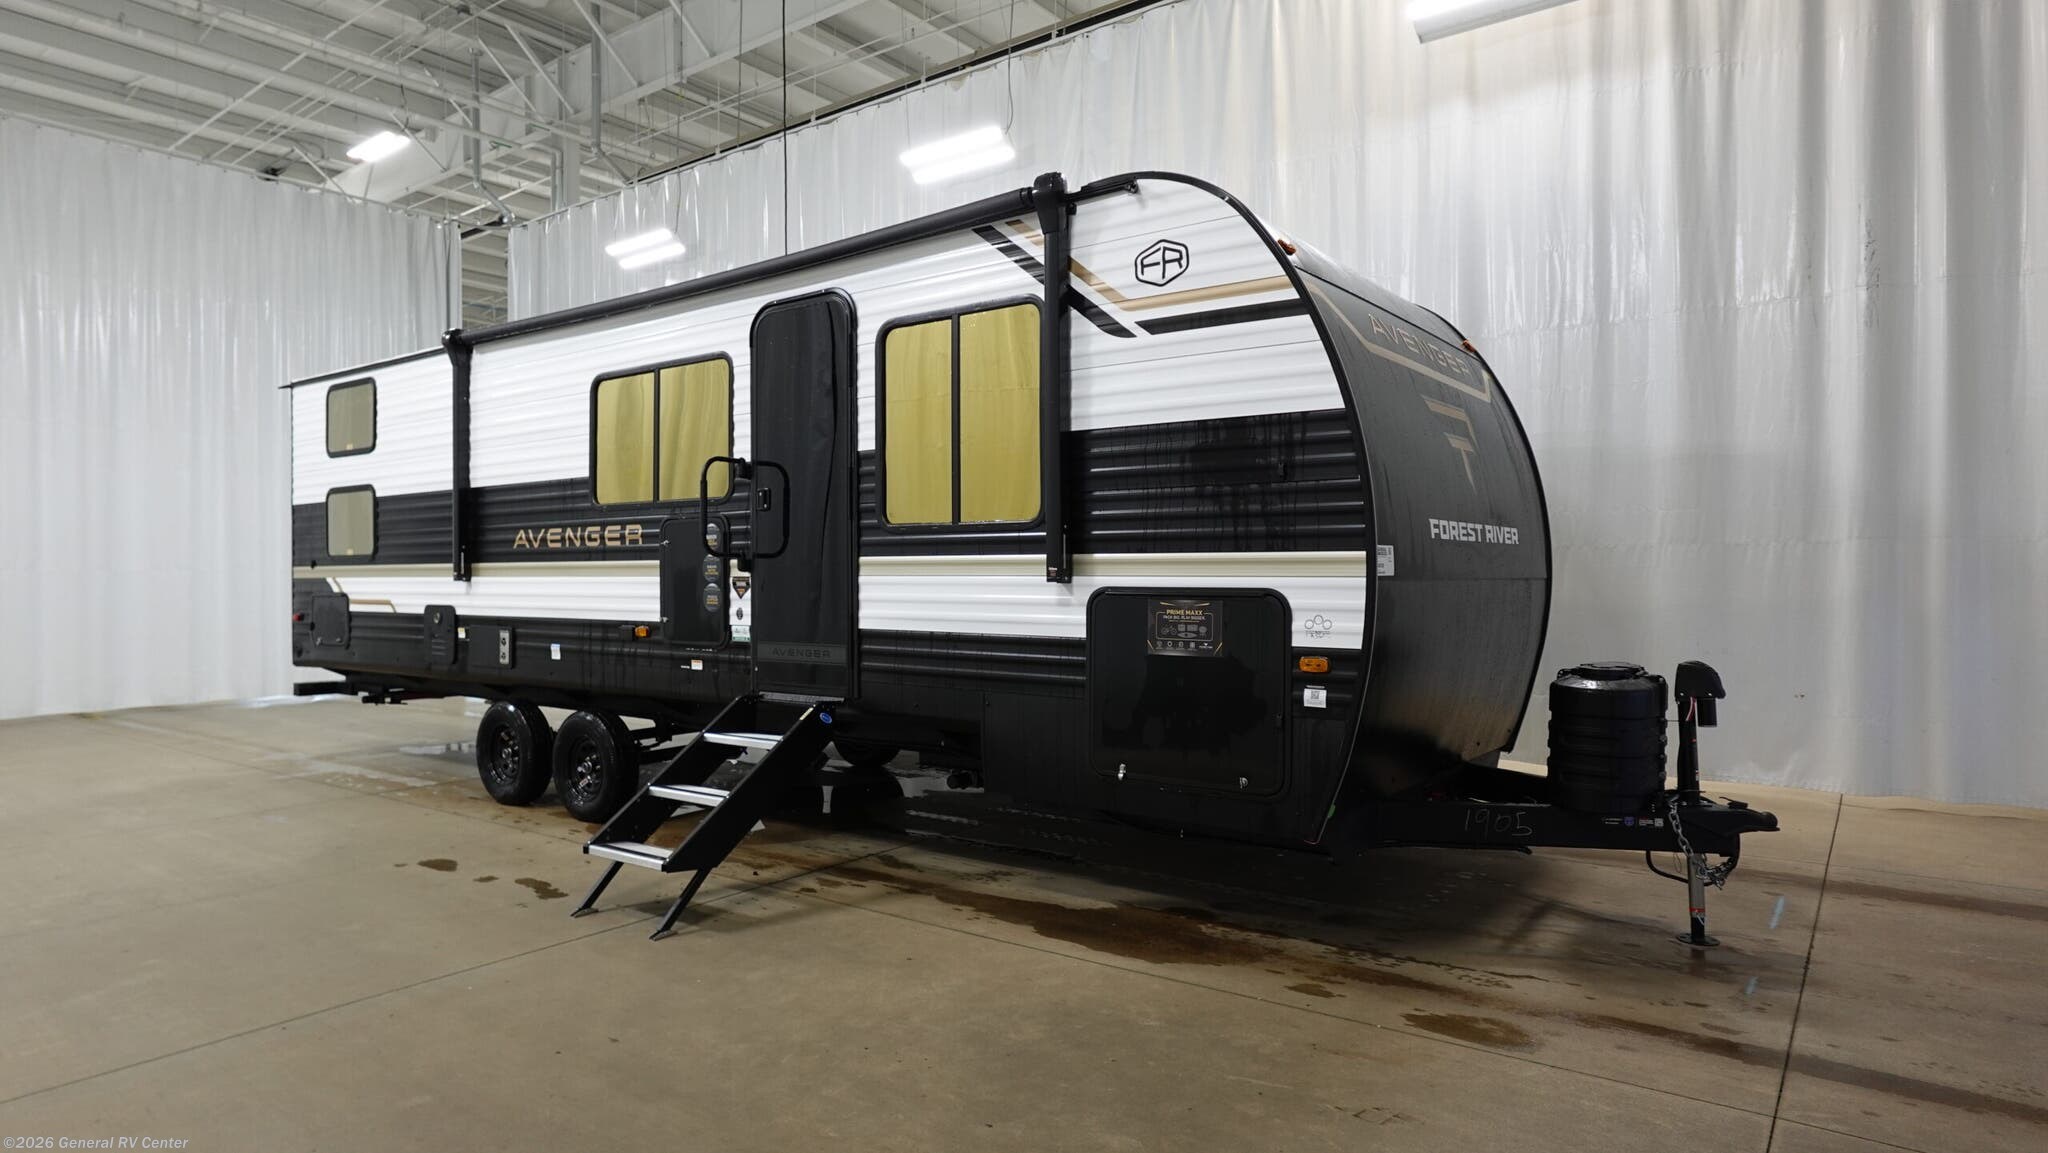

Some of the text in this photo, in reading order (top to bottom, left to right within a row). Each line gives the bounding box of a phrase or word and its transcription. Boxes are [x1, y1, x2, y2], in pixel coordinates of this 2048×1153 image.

[1140, 245, 1183, 280] FR
[1368, 313, 1472, 378] AVENGER
[513, 523, 643, 549] AVENGER
[1428, 518, 1519, 545] FOREST RIVER
[771, 646, 832, 658] AVENGER
[1464, 807, 1533, 838] 1905
